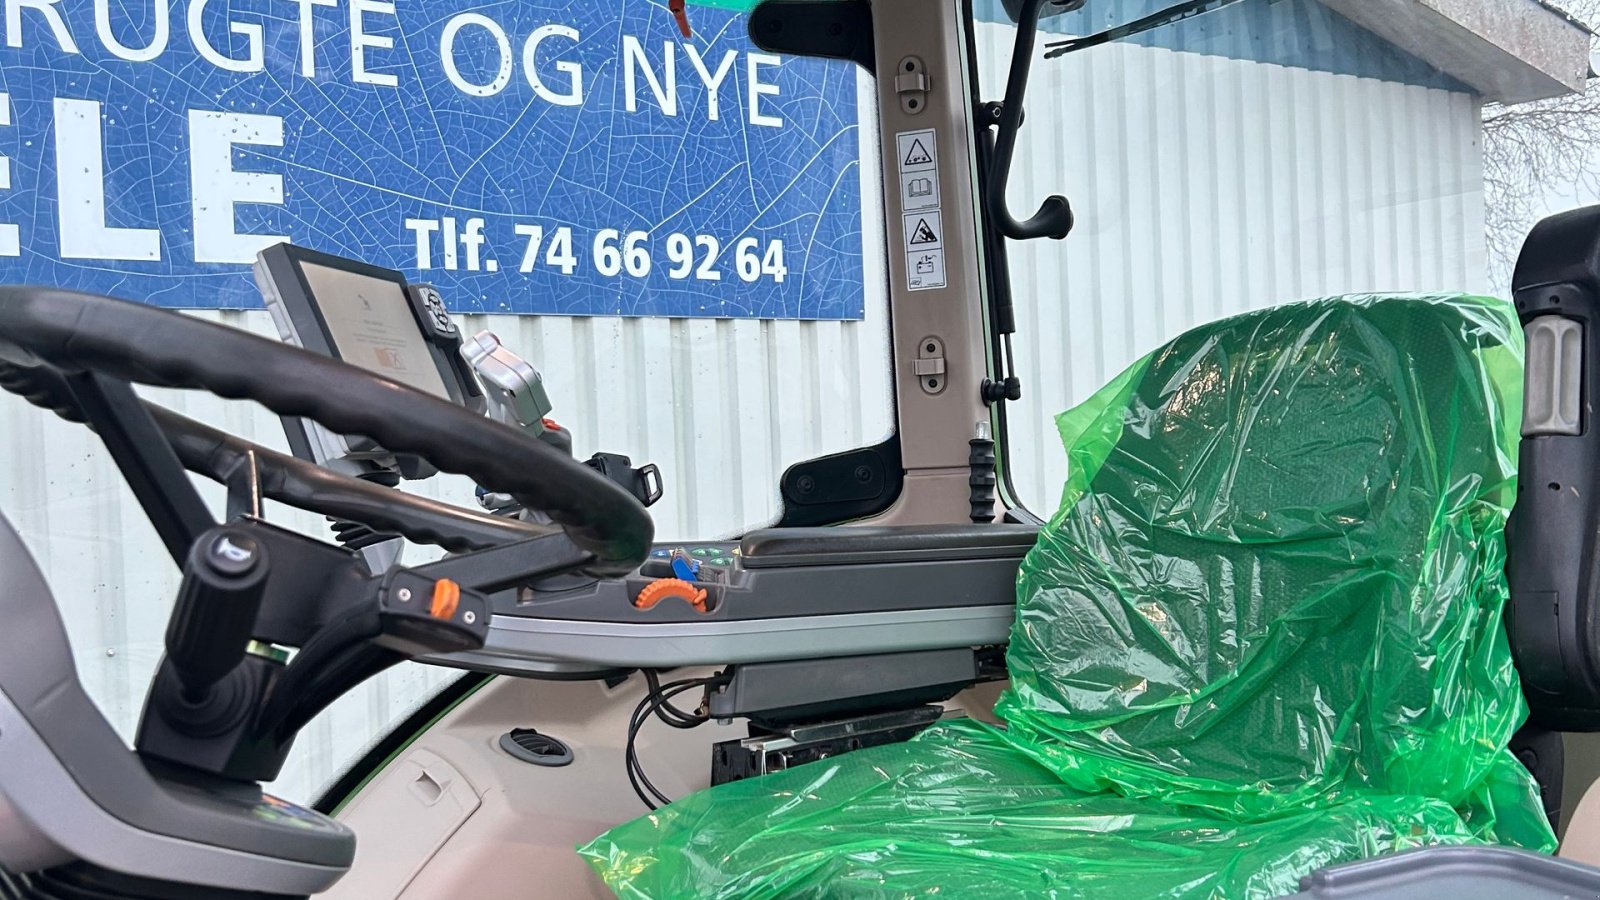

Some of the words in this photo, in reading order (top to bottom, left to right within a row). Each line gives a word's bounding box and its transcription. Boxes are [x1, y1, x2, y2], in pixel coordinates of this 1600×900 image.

[440, 12, 584, 107] OG
[623, 34, 783, 128] NYE
[0, 92, 292, 264] LE
[405, 217, 498, 274] Tlf.
[514, 224, 577, 275] 74
[593, 228, 651, 279] 66
[666, 233, 721, 281] 92
[735, 237, 788, 284] 64
